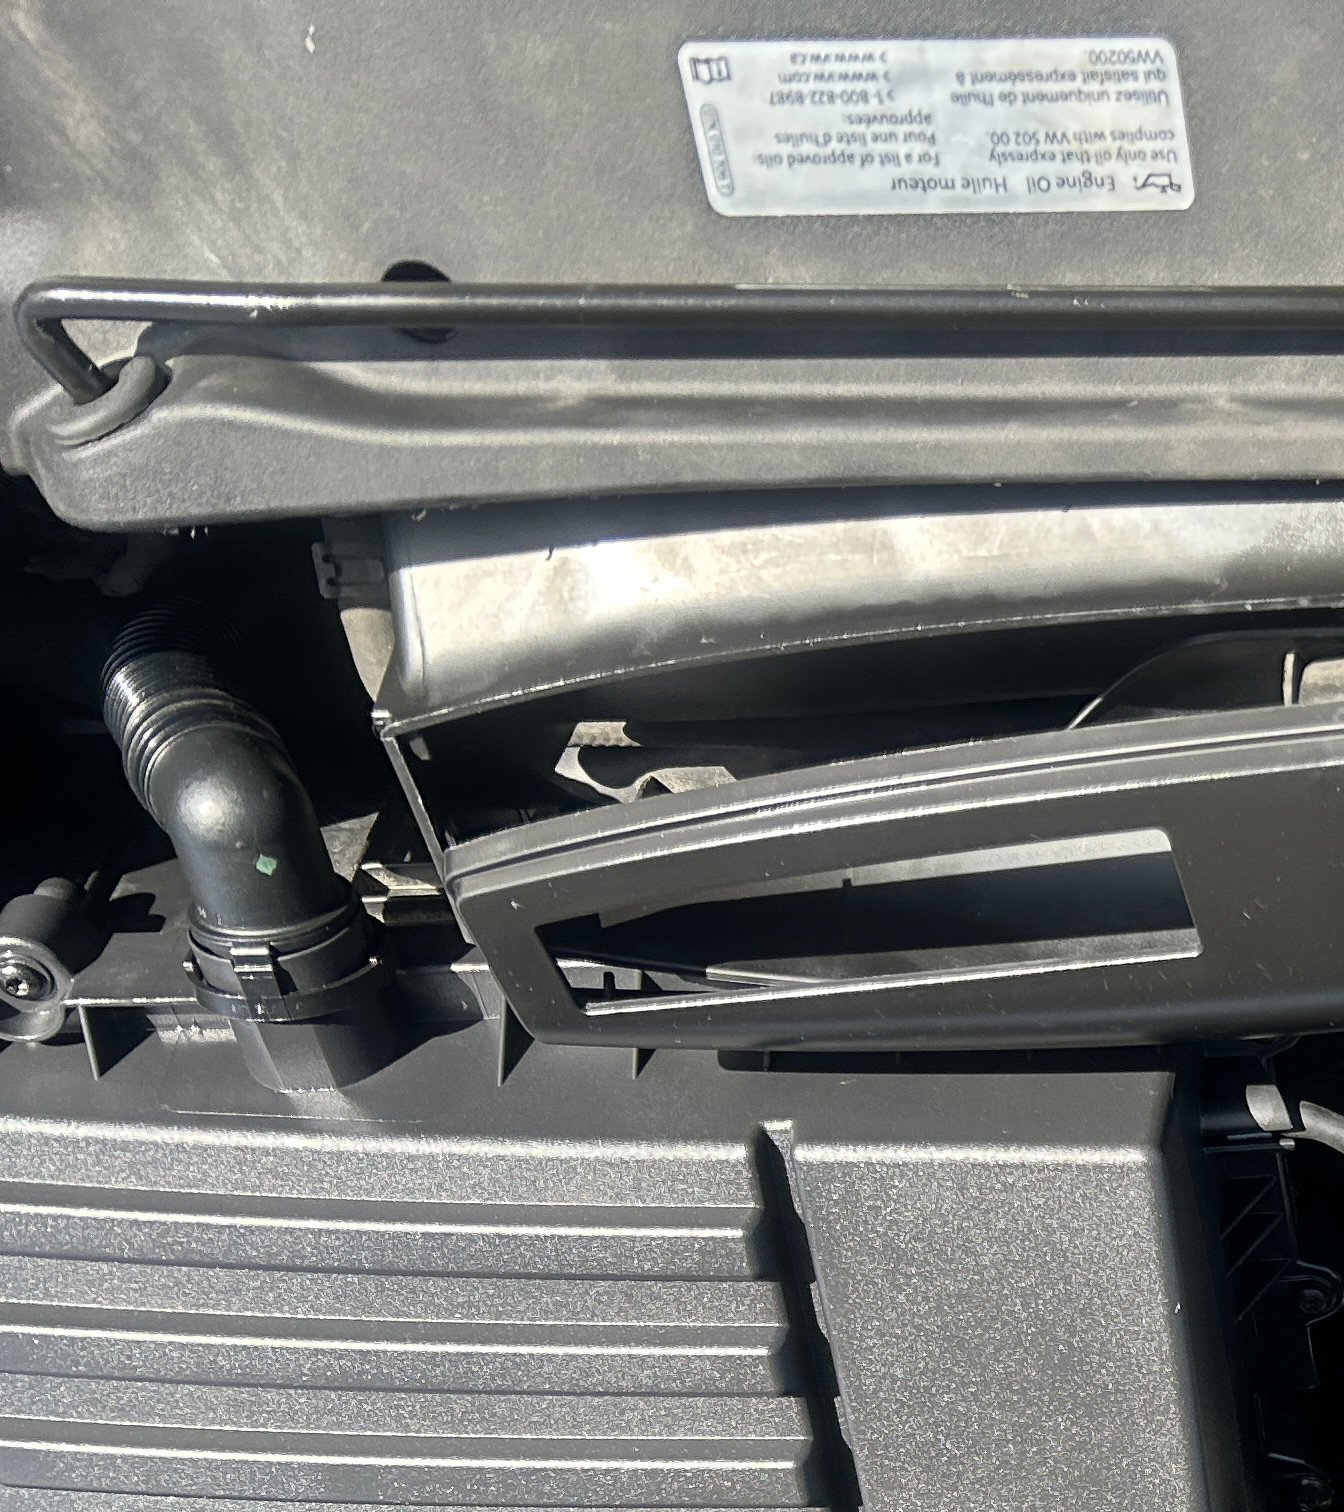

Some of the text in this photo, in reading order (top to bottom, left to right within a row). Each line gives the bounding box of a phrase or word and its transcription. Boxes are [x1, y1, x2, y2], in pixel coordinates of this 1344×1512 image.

[1081, 70, 1139, 86] satisfait
[1144, 68, 1167, 85] qui
[998, 91, 1018, 106] de
[1021, 86, 1110, 106] uniquement
[1115, 89, 1169, 106] Utilisez
[775, 131, 936, 147] Pour une liste d'huiles
[1014, 132, 1040, 146] 502
[1044, 132, 1069, 146] VW
[1073, 131, 1106, 147] with
[1110, 126, 1175, 146] complies
[786, 147, 855, 168] approved
[859, 153, 874, 168] of
[878, 152, 901, 168] list
[917, 152, 940, 167] For
[988, 146, 1178, 167] Use only oil that expressly
[891, 176, 1008, 194] Huile moteur
[1026, 171, 1115, 193] Engine Oil
